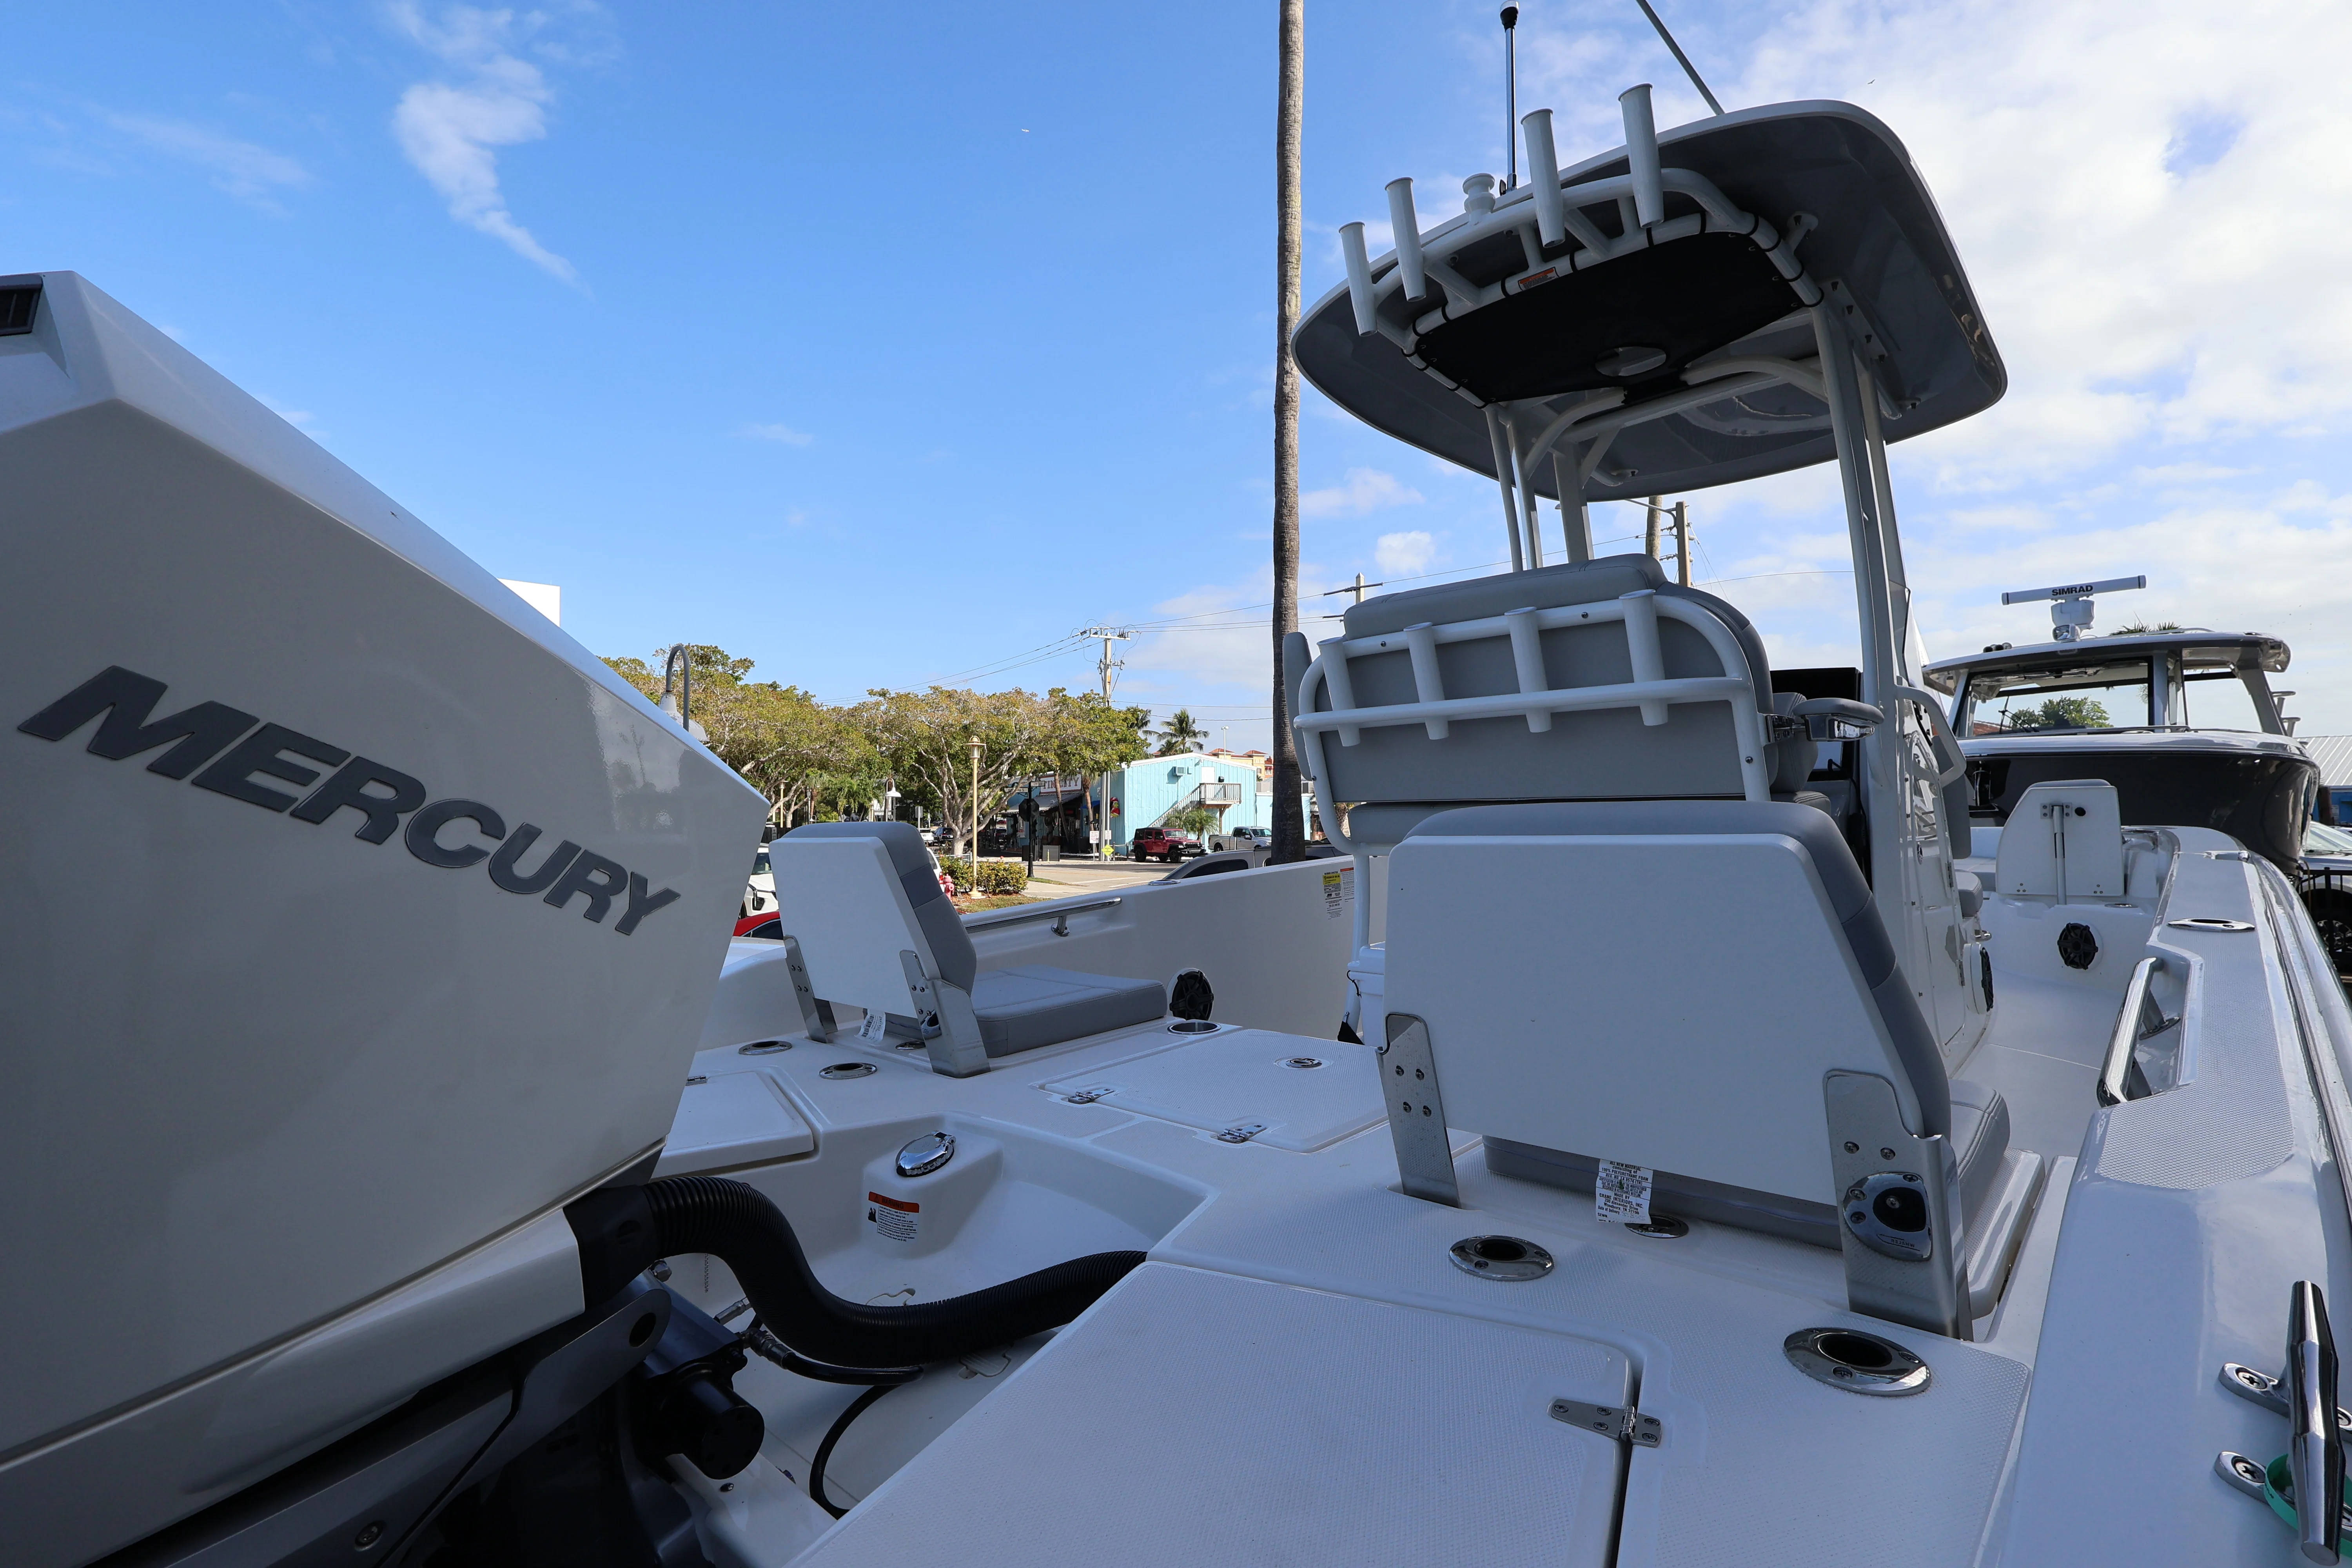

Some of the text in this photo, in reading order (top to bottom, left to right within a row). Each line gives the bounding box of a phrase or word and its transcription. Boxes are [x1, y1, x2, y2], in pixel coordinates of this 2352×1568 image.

[2052, 585, 2093, 596] SIMRAD
[16, 665, 681, 936] MERCURY
[1612, 1169, 1637, 1179] POLYURETHANE
[882, 1197, 904, 1209] WARNING
[1611, 1200, 1628, 1208] Alexander
[1613, 1197, 1634, 1207] INTERIORS,
